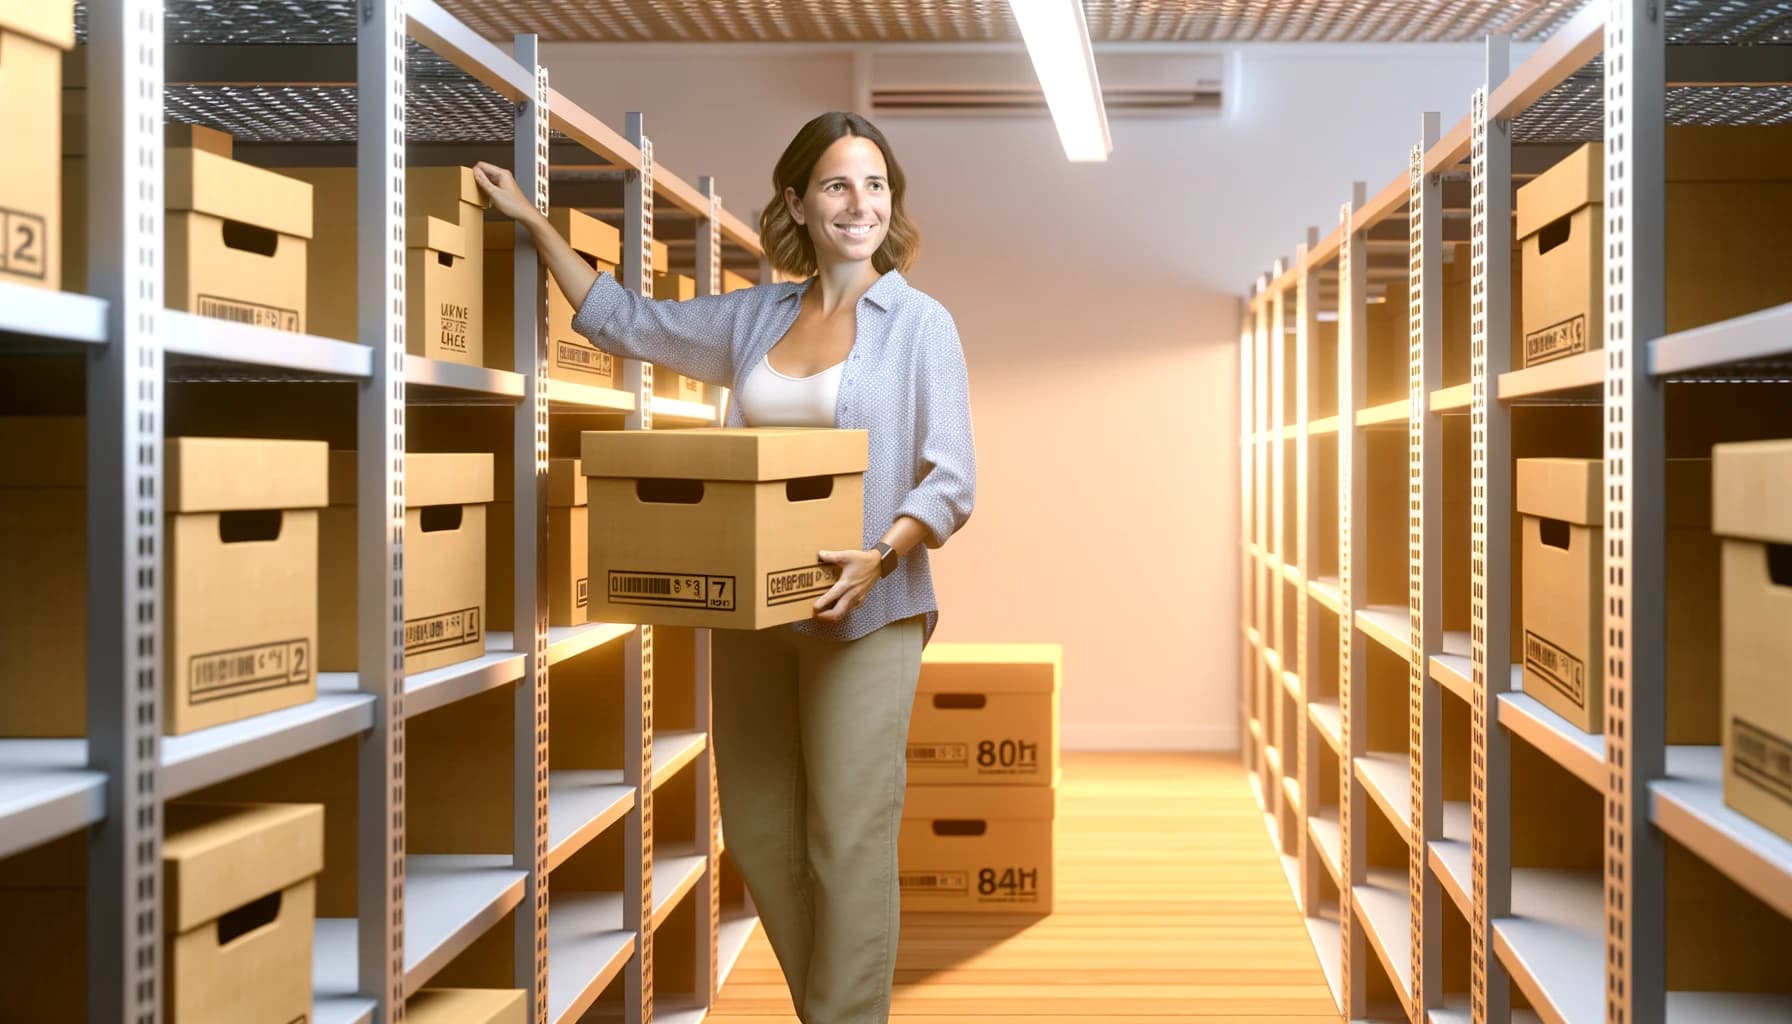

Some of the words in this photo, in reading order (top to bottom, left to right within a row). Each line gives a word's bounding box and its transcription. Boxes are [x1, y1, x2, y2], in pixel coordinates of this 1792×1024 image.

[15, 224, 36, 262] 2
[711, 581, 726, 597] 7
[291, 646, 305, 677] 2
